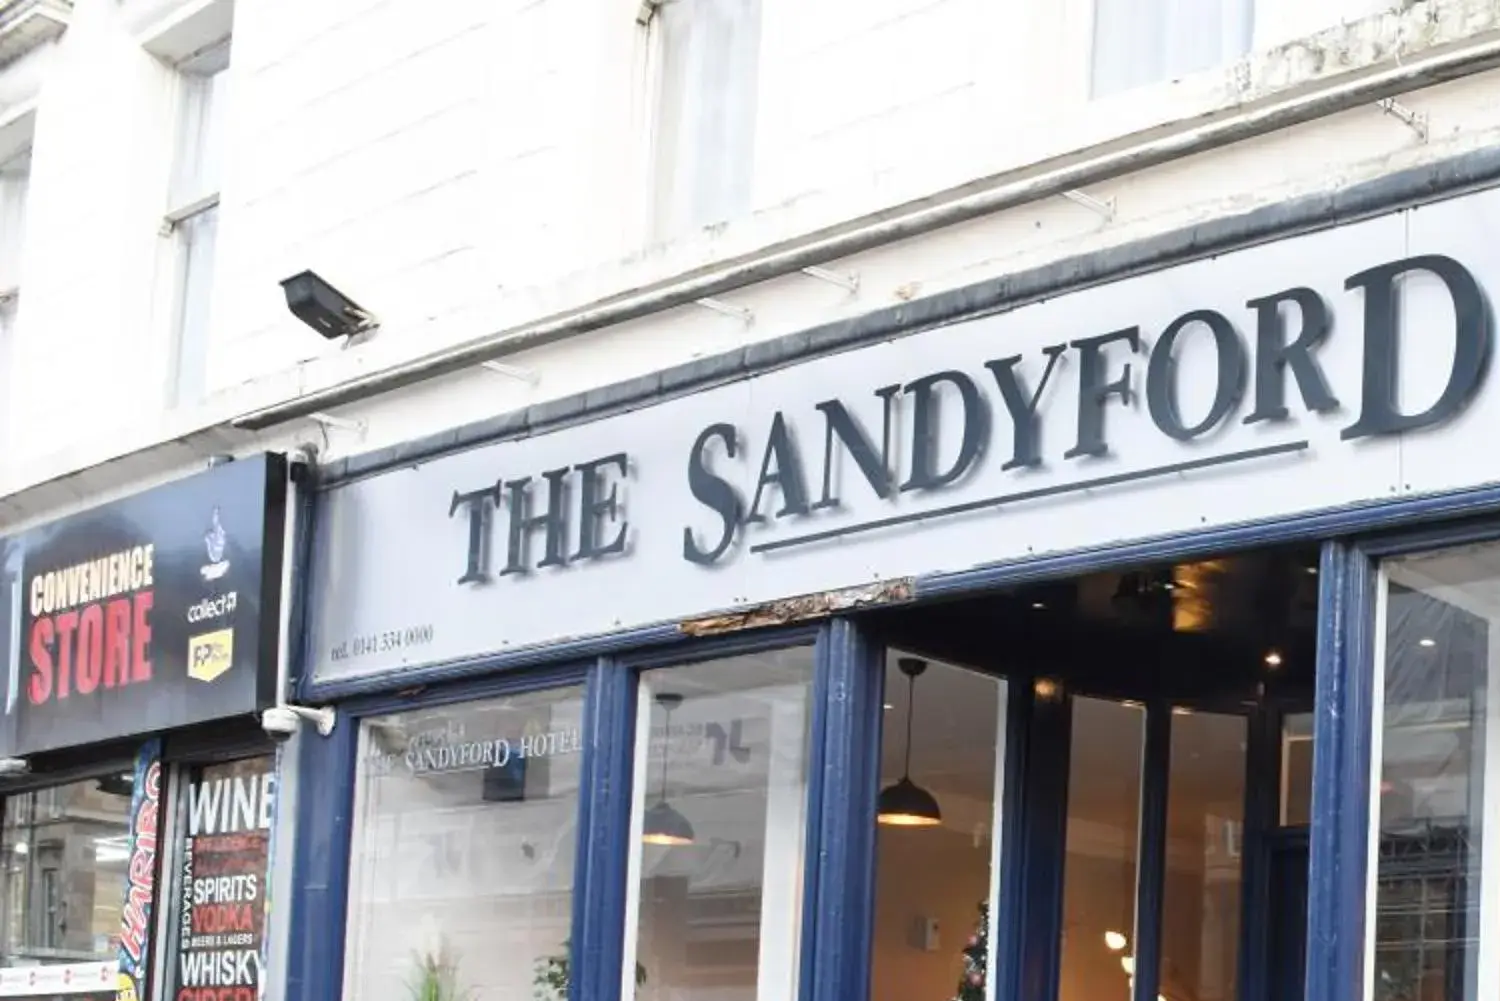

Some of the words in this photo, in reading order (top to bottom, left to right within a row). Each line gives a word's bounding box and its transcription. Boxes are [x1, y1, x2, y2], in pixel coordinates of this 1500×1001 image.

[450, 453, 628, 585] THE
[683, 254, 1494, 566] SANDYFORD
[31, 543, 154, 617] CONVENIENCE
[28, 591, 155, 705] STORE
[405, 739, 510, 771] SANDYFORD
[518, 728, 582, 760] HOTEL
[192, 903, 254, 932] VODKA
[193, 874, 257, 904] SPIRITS
